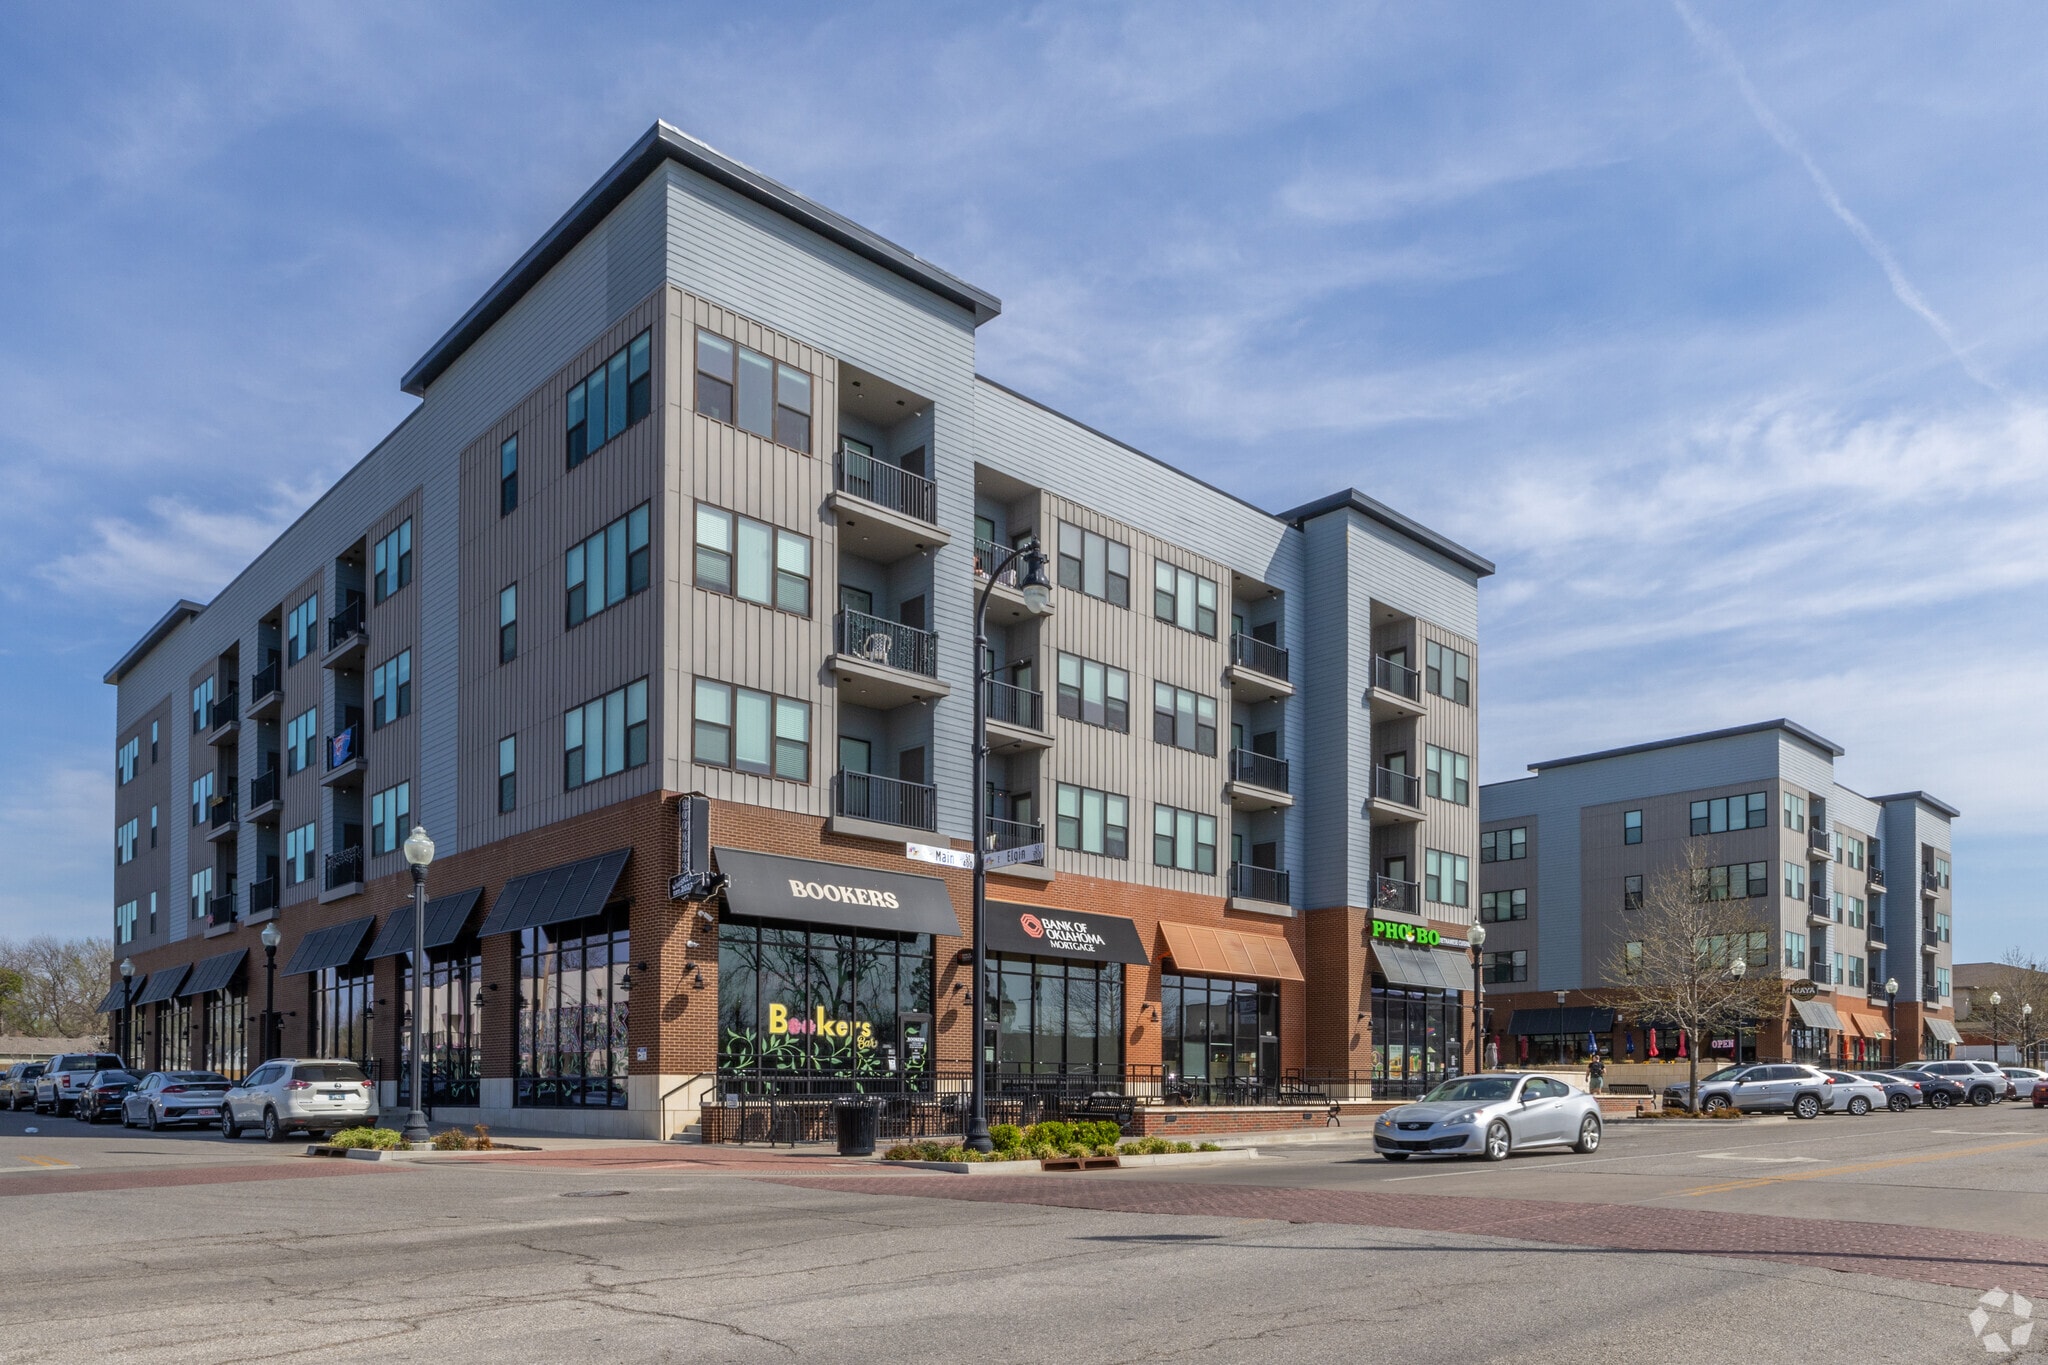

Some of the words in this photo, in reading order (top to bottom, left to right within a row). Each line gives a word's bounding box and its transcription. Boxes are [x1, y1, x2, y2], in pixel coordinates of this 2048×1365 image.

[935, 850, 955, 864] Main
[997, 854, 1001, 864] E
[1007, 848, 1026, 864] Elgin
[788, 879, 900, 909] BOOKERS
[1041, 918, 1074, 932] BANK
[1073, 922, 1087, 933] OF
[1372, 920, 1414, 942] PHO
[1416, 927, 1441, 946] BO
[1046, 928, 1106, 945] OKLAHOMA
[1050, 940, 1096, 953] MORTGAGE
[769, 1003, 872, 1037] Bookers
[857, 1035, 878, 1049] Bar
[1711, 1039, 1734, 1048] OPEN
